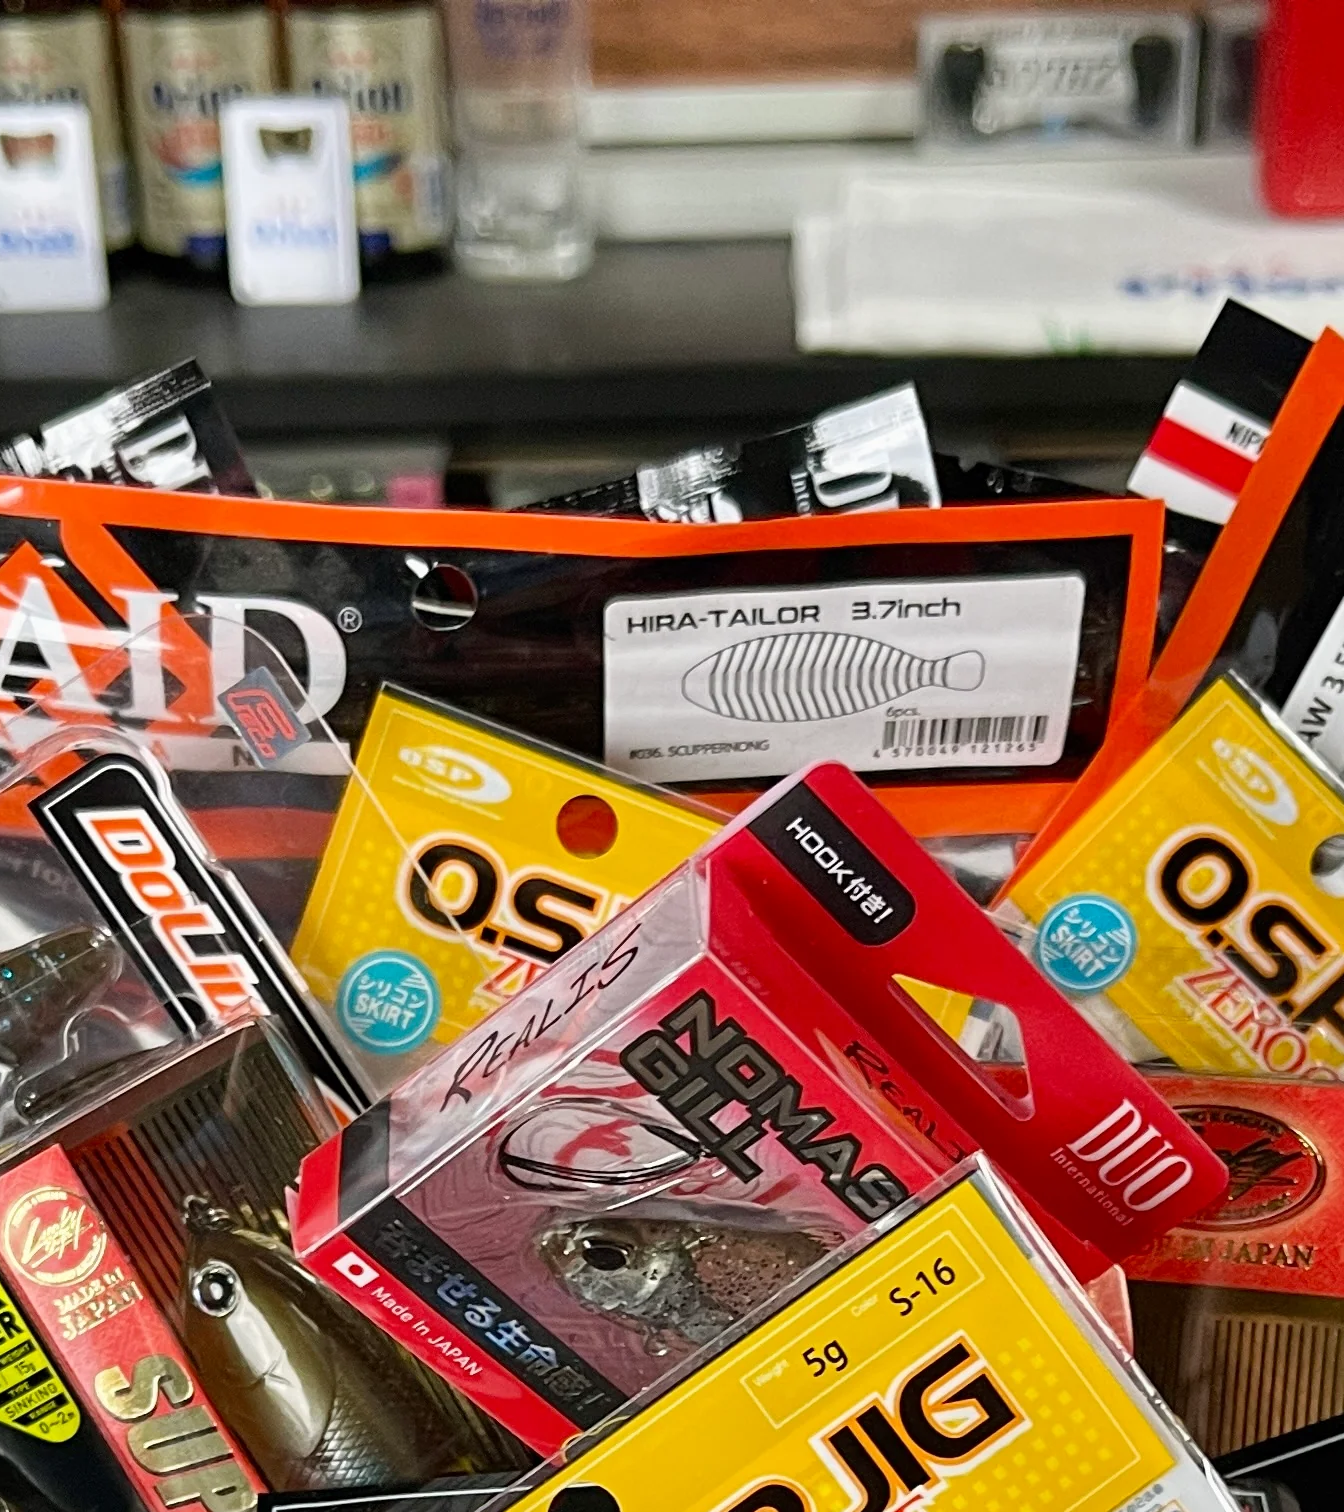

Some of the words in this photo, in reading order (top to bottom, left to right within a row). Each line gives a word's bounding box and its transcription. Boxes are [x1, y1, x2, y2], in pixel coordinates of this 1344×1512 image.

[627, 603, 821, 635] HIRA-TAILOR
[852, 596, 961, 622] 3.7inch
[667, 739, 770, 758] SCUPPERNONG
[785, 815, 895, 926] HOOK付き!
[357, 971, 426, 1010] シリコン
[1046, 922, 1108, 982] SKIRT
[354, 994, 418, 1030] SKIRT
[441, 923, 643, 1115] REALIS
[619, 1028, 768, 1184] GILL
[658, 987, 911, 1224] NOMAS
[1049, 1146, 1135, 1227] International
[1065, 1097, 1193, 1213] DUO
[370, 1285, 414, 1324] Made
[426, 1333, 484, 1377] JAPAN
[802, 1339, 850, 1378] 5g
[887, 1256, 957, 1317] S-16
[4, 1380, 59, 1420] SINKING
